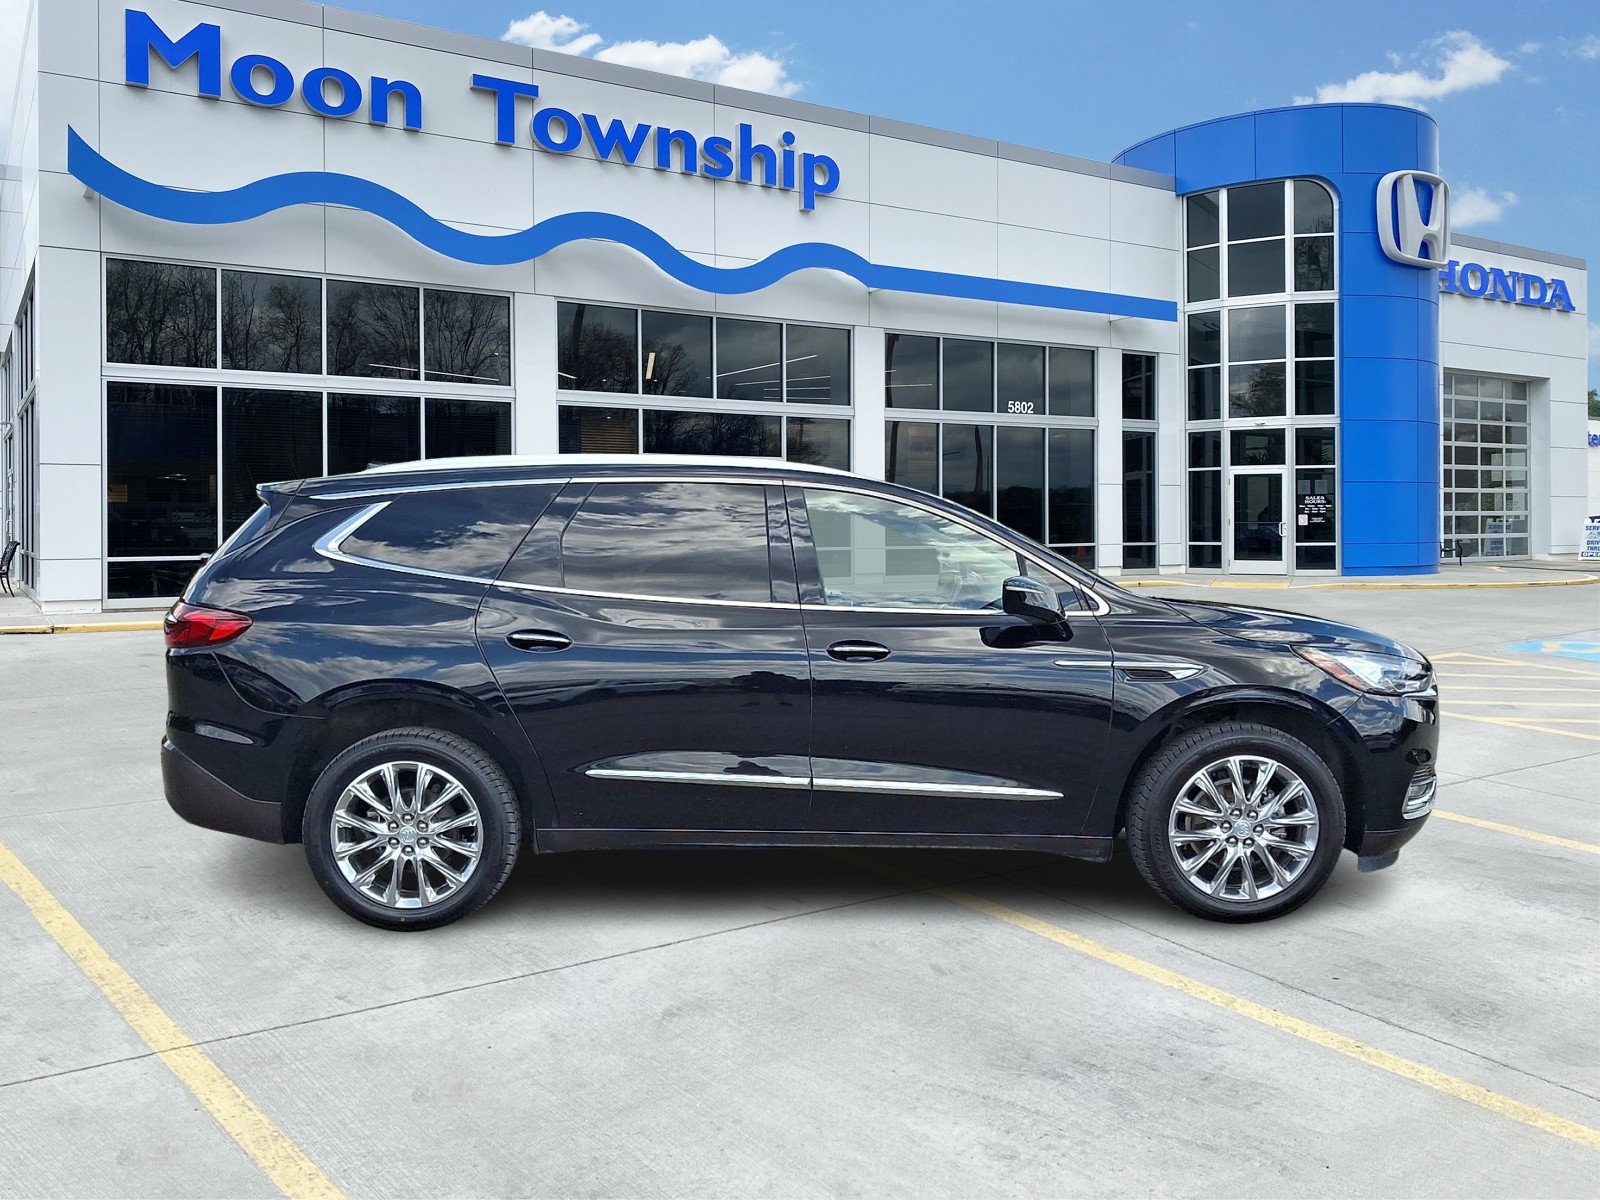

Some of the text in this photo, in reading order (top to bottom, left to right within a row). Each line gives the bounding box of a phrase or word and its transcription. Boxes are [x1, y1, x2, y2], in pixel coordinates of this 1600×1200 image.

[125, 9, 840, 212] Moon Township
[1439, 259, 1577, 312] HONDA
[1007, 400, 1034, 414] 5802
